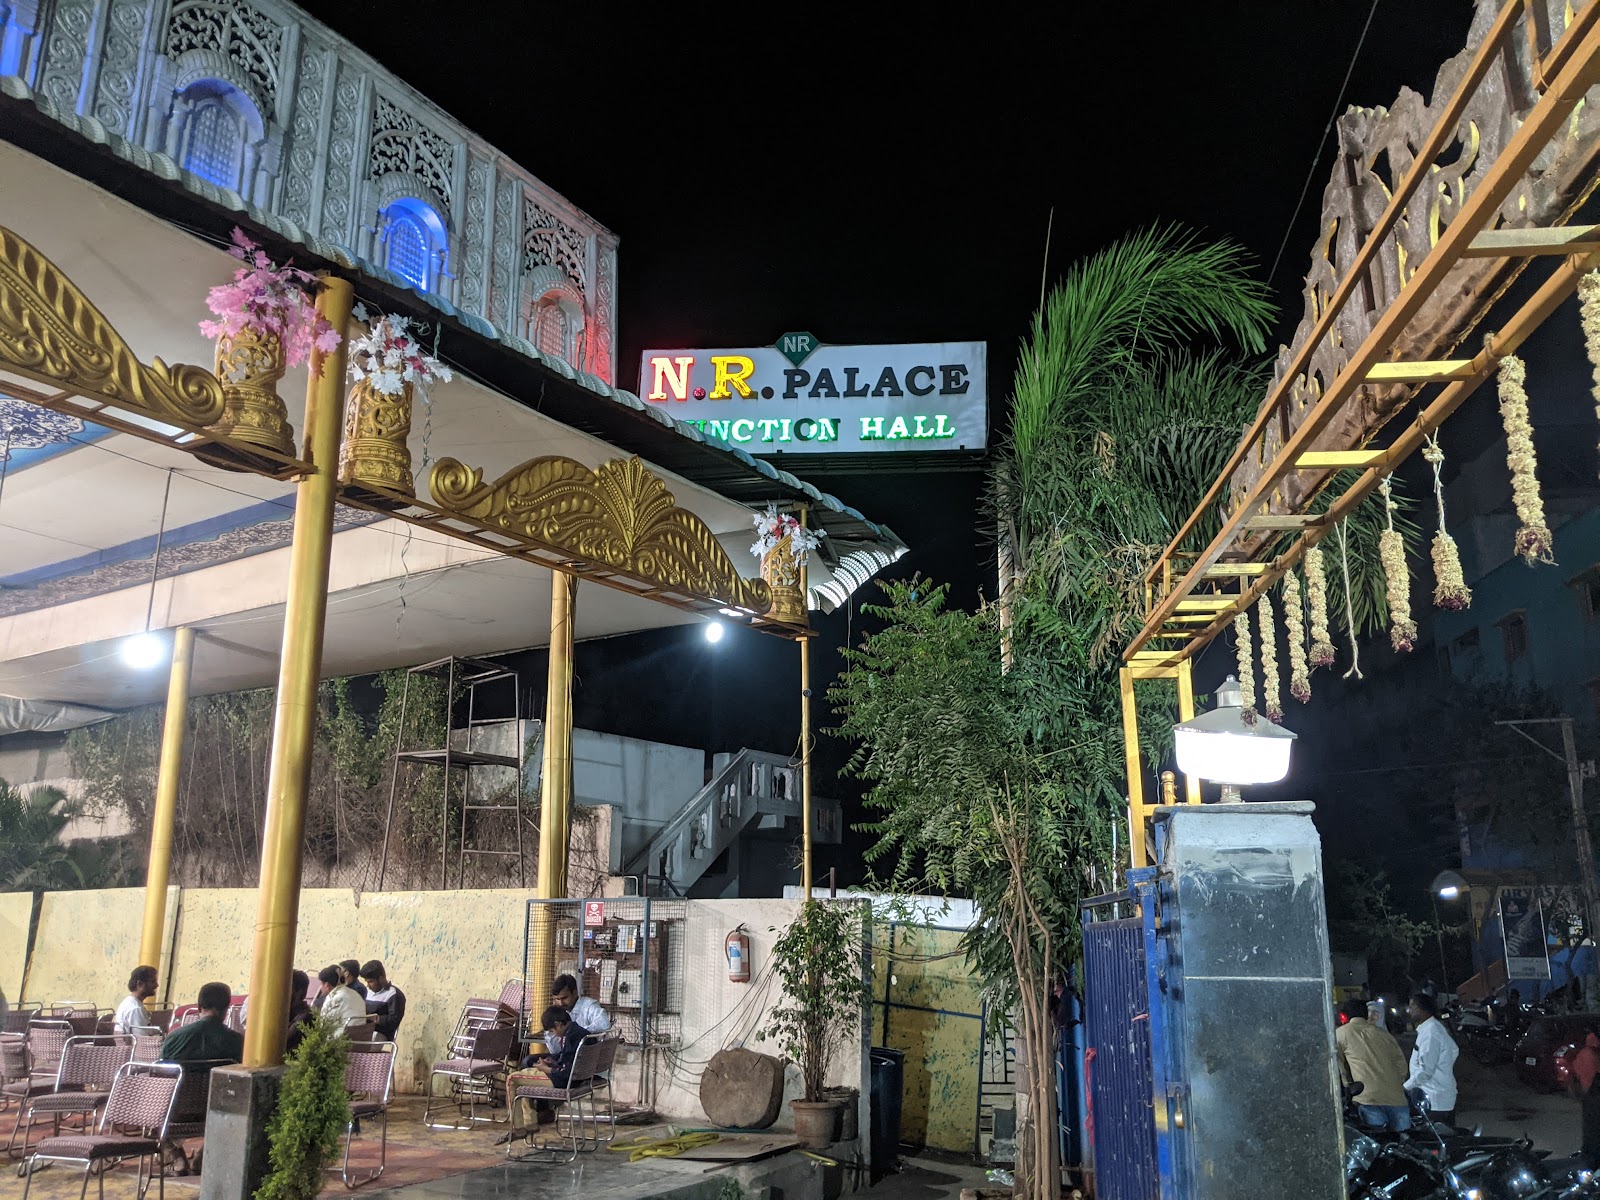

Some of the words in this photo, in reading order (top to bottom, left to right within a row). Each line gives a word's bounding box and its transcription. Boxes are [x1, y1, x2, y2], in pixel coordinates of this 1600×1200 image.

[783, 335, 810, 353] NR
[783, 364, 970, 399] PALACE
[685, 418, 841, 442] NCTION
[859, 414, 956, 440] HALL
